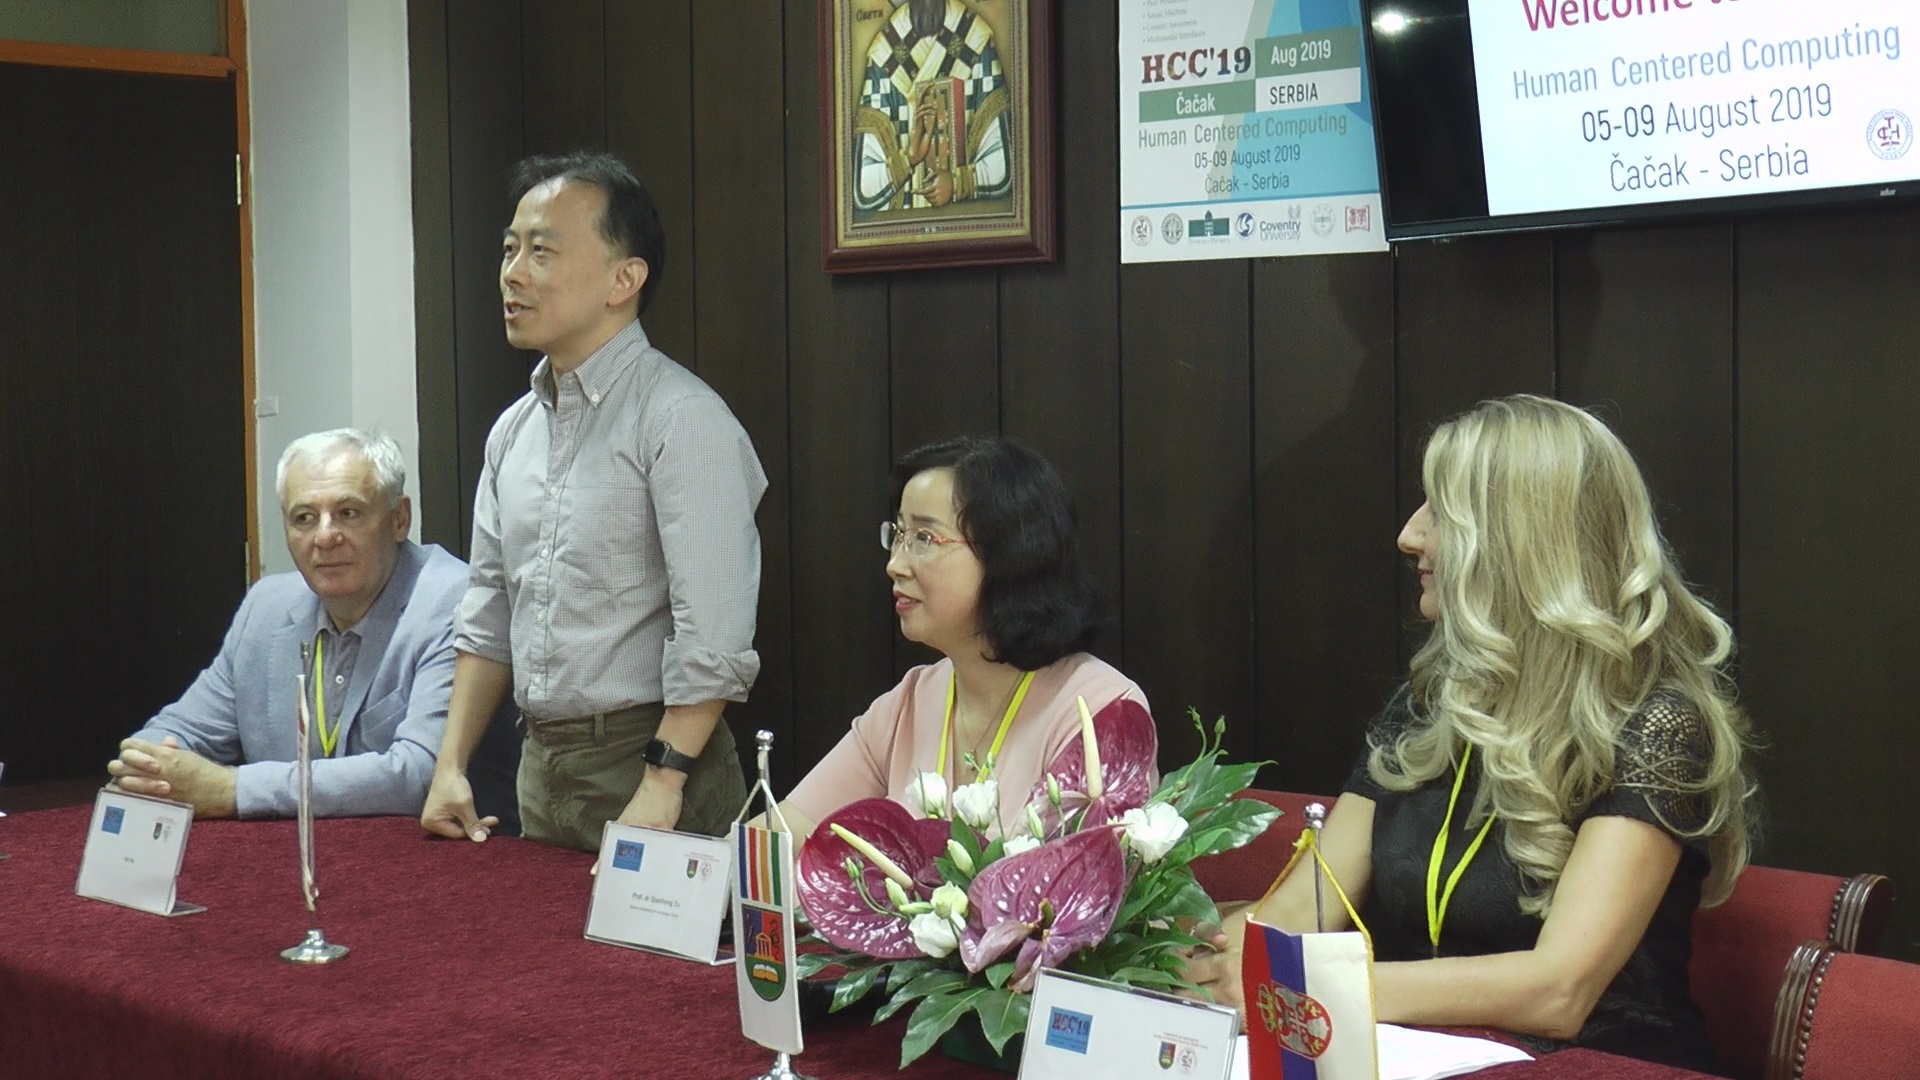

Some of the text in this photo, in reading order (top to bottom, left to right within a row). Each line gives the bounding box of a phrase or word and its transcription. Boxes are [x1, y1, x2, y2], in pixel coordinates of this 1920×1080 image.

[1141, 46, 1252, 84] HCC'19
[1270, 39, 1332, 67] Aug 2019
[1513, 22, 1902, 100] Human Centered Computing
[1175, 92, 1216, 115] Čačak
[1269, 82, 1319, 105] SERBIA
[1581, 83, 1833, 142] 05-09 August 2019
[1138, 112, 1348, 149] Human Centered Computing
[1194, 144, 1301, 169] 05-09 August 2019
[1610, 152, 1690, 193] Čačak
[1718, 142, 1810, 182] Serbia
[1252, 171, 1290, 190] Serbia
[1259, 219, 1301, 233] Coventry
